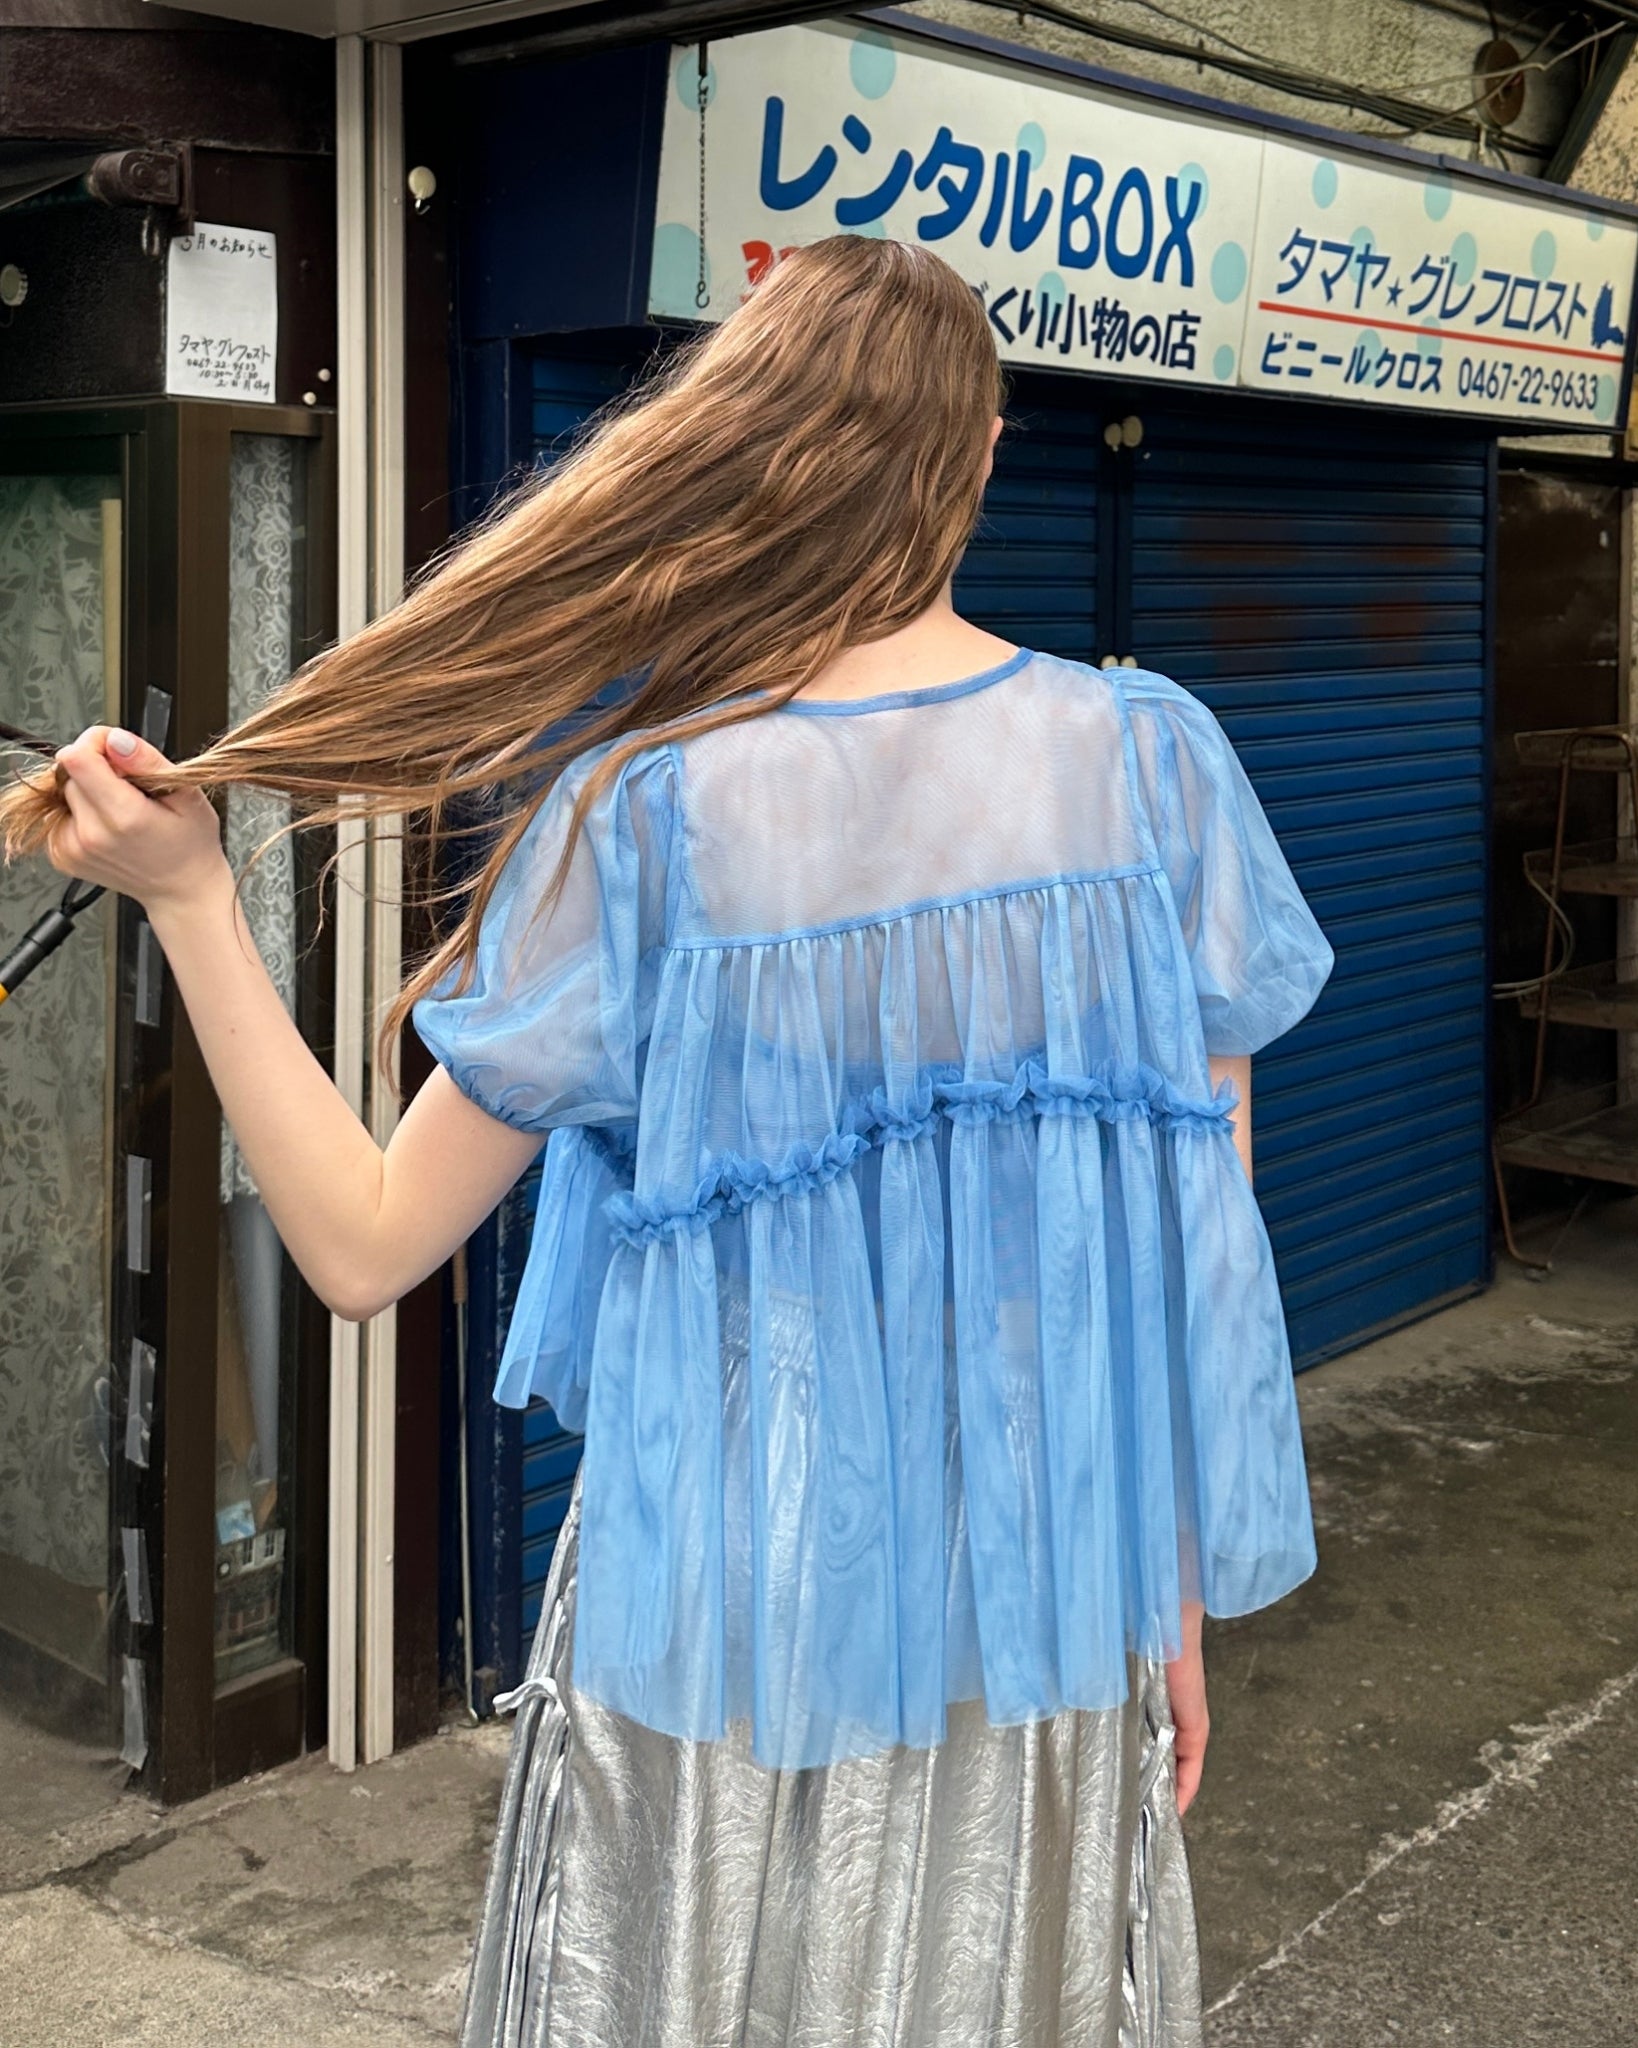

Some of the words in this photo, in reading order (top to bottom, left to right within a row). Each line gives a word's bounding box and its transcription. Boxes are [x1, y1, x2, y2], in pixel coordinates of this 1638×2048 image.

[760, 96, 1202, 288] レンタルBOX
[1260, 332, 1443, 394] ビニールクロス
[1457, 357, 1600, 411] 0467-22-9633
